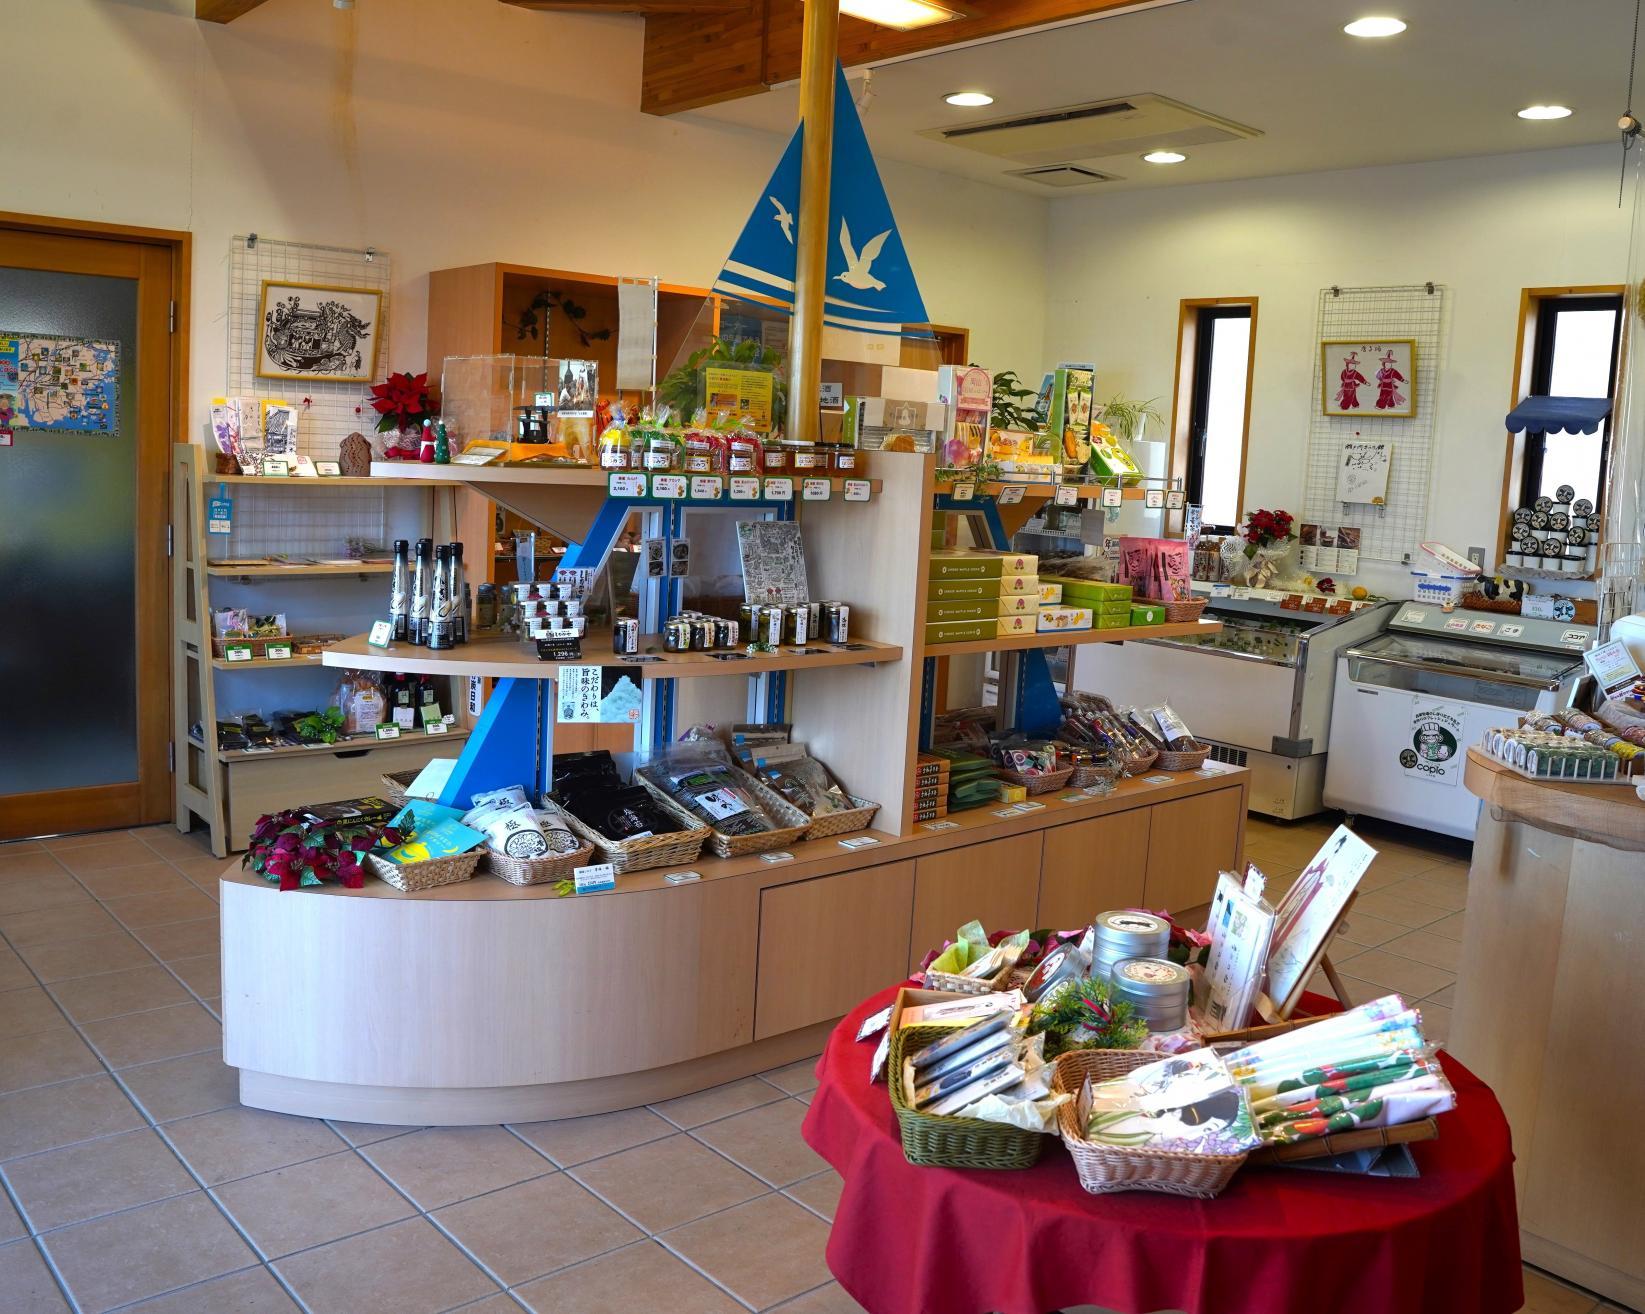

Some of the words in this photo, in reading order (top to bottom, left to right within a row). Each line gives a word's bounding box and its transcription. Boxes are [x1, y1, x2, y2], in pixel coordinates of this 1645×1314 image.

[580, 667, 591, 720] 旨味のきわみ。
[590, 668, 600, 712] こだわりは、
[1416, 763, 1446, 776] copio
